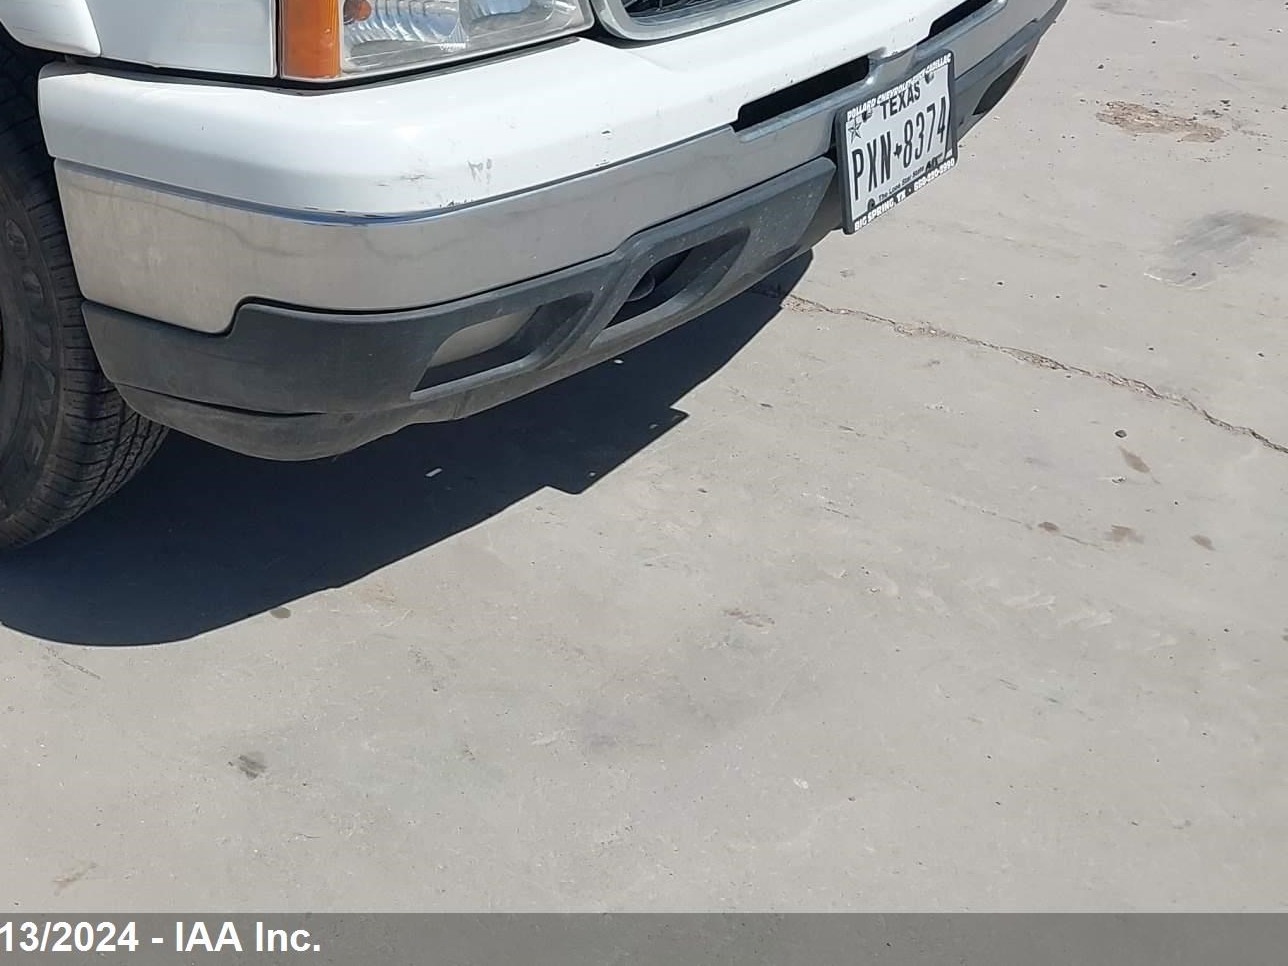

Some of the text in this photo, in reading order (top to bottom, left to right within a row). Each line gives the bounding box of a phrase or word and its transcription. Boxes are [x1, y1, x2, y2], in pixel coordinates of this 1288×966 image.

[847, 97, 877, 122] POLLARD
[880, 80, 921, 120] TEXAS
[878, 166, 925, 202] The Lone Star State
[854, 215, 868, 232] BIG
[896, 189, 907, 203] TX
